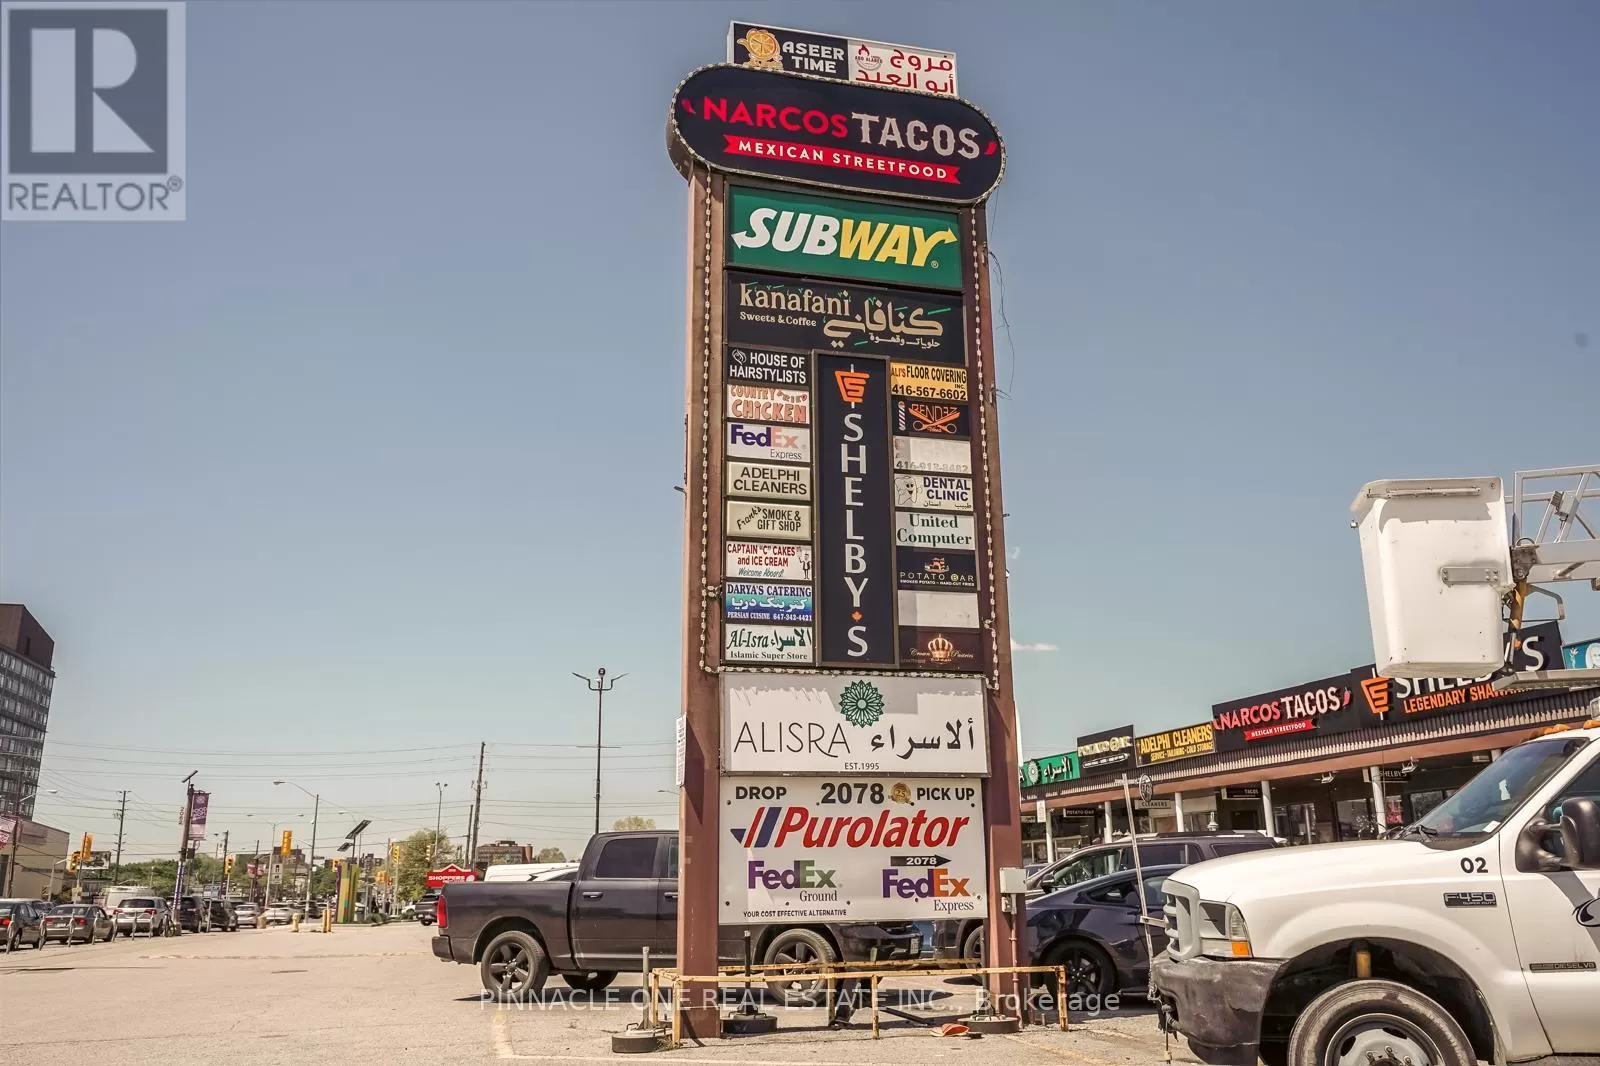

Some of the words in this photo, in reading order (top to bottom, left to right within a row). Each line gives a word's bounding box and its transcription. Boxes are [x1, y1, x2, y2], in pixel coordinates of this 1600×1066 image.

[782, 41, 845, 61] ASEER
[791, 55, 837, 74] TIME
[890, 48, 953, 72] فروج
[703, 96, 848, 138] NARCOS
[851, 111, 980, 160] TACOS
[738, 139, 824, 162] MEXICAN
[833, 152, 948, 179] STREETFOOD
[739, 282, 851, 316] kanafani
[739, 311, 776, 324] Sweets
[786, 314, 817, 327] Coffee
[749, 352, 788, 368] HOUSE
[790, 356, 805, 369] OF
[729, 365, 806, 384] HAIRSTYLISTS
[906, 365, 929, 380] FLOOR
[931, 367, 967, 384] COVERING
[892, 384, 967, 400] 416-567-6602
[731, 424, 799, 449] FedEx
[770, 449, 802, 460] Express
[740, 466, 800, 482] ADELPHI
[733, 479, 808, 495] CLEANERS
[923, 476, 971, 491] DENTAL
[926, 489, 968, 502] CLINIC
[762, 508, 793, 521] SMOKE
[794, 510, 802, 521] &
[909, 513, 958, 528] United
[757, 519, 776, 530] GIFT
[778, 521, 802, 532] SHOP
[896, 528, 972, 547] Computer
[727, 543, 758, 555] CAPTAIN
[772, 546, 796, 557] CAKES
[737, 555, 750, 565] and
[751, 557, 763, 566] ICE
[764, 557, 789, 567] CREAM
[900, 571, 945, 581] POTATO
[727, 583, 764, 596] DARYA'S
[766, 585, 812, 598] CATERING
[727, 611, 749, 619] PERSIAN
[750, 612, 771, 620] CUISINE
[726, 628, 769, 649] Al-Isra
[730, 651, 760, 659] Islamic
[761, 652, 785, 661] Super
[786, 652, 808, 660] Store
[1219, 700, 1281, 731] NARCOS
[1280, 686, 1341, 719] TACOS
[1403, 688, 1467, 714] LEGENDARY
[733, 721, 851, 758] ALISRA
[1140, 733, 1170, 754] ADELPHI
[1172, 724, 1213, 747] CLEANERS
[1251, 727, 1273, 738] MEXICAN
[844, 762, 880, 771] EST.1995
[735, 786, 787, 800] DROP
[820, 782, 885, 804] 2078
[916, 787, 951, 801] PICK
[955, 788, 975, 801] UP
[774, 806, 970, 848] Purolator
[906, 857, 937, 865] 2078
[1460, 856, 1488, 873] 02
[748, 859, 837, 889] FedEx
[882, 867, 970, 898] FedEx
[799, 890, 838, 902] Ground
[743, 910, 759, 918] YOUR
[777, 909, 808, 917] EFFECTIVE
[808, 908, 847, 917] ALTERNATIVE
[933, 899, 974, 914] Express
